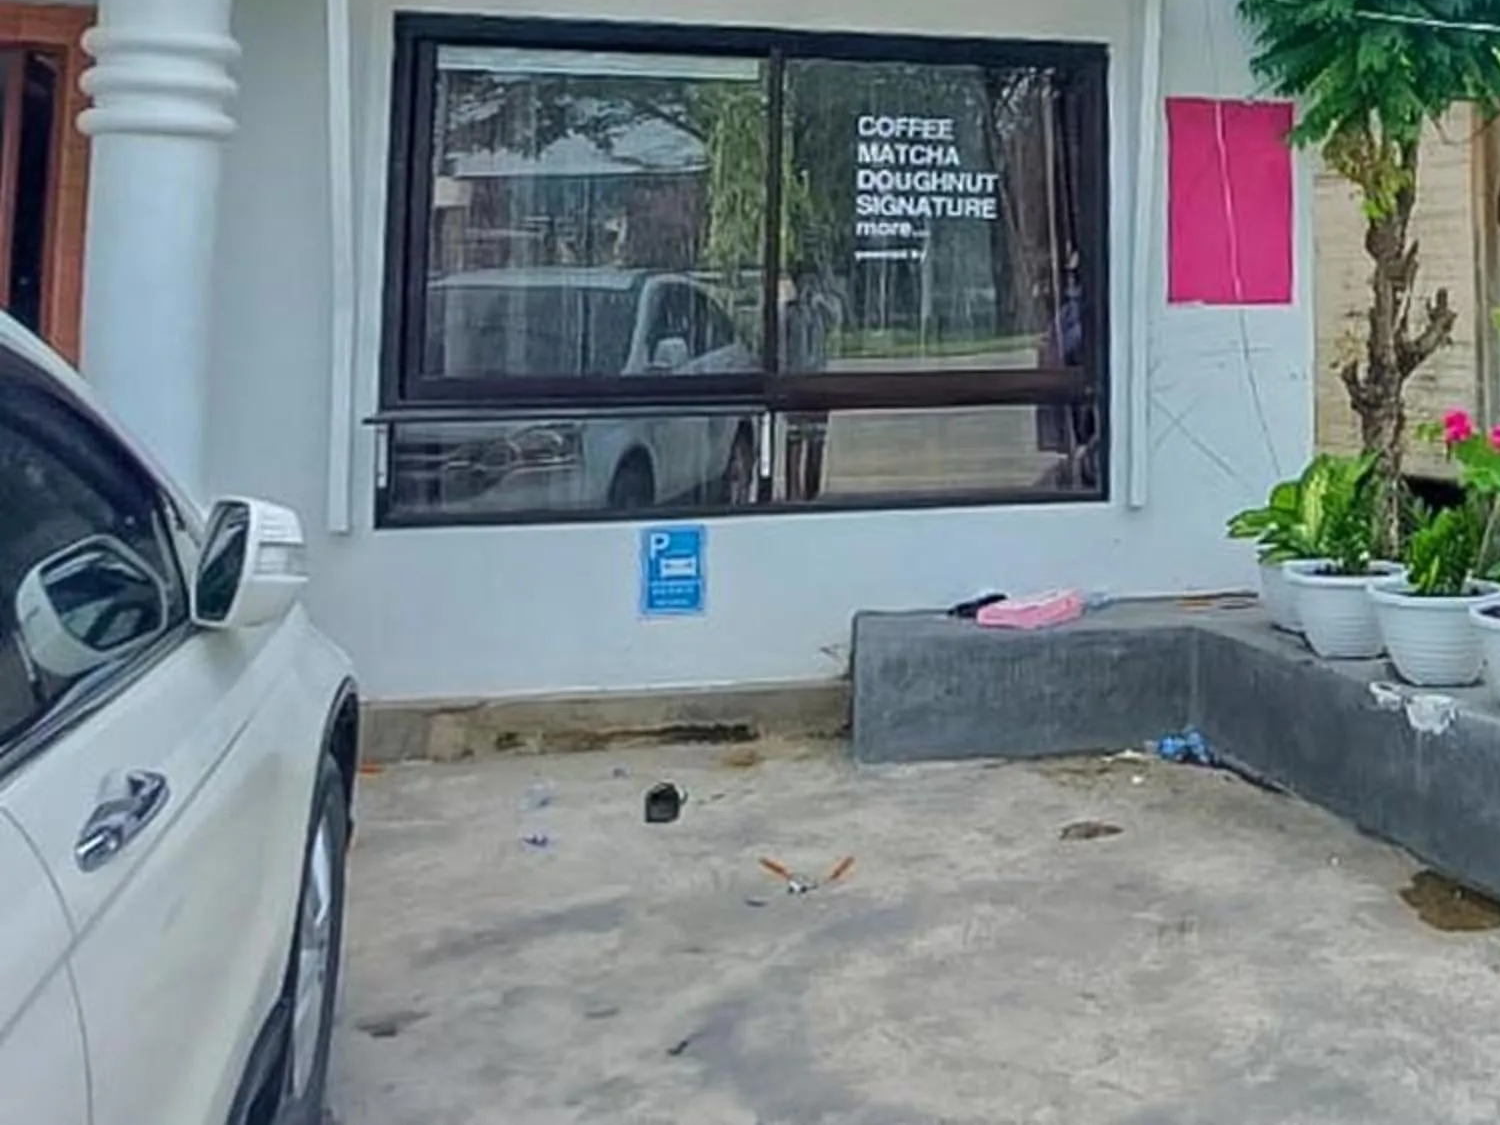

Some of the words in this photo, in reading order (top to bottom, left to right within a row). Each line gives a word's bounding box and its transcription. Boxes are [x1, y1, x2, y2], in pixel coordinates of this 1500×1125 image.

[858, 116, 954, 140] COFFEE
[858, 143, 960, 165] MATCHA
[857, 169, 999, 192] DOUGHNUT
[856, 194, 998, 219] SIGNATURE
[650, 533, 670, 560] P
